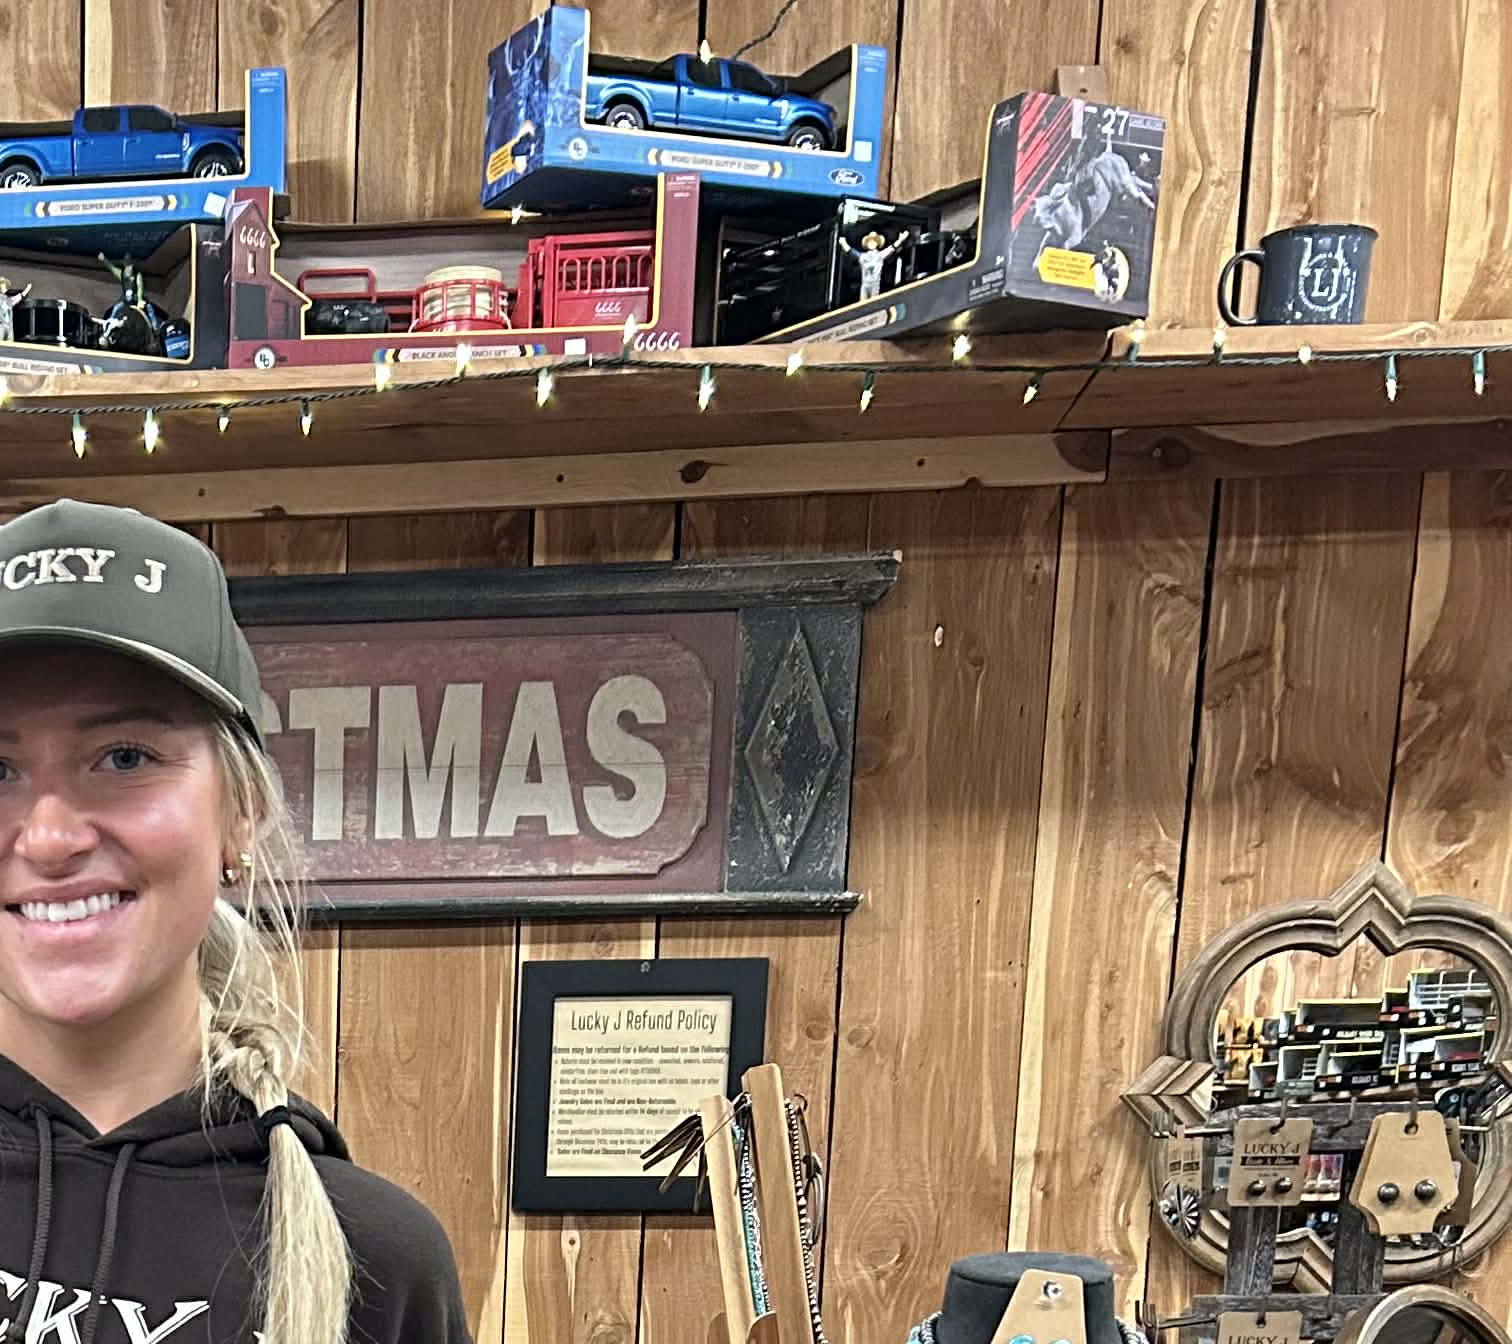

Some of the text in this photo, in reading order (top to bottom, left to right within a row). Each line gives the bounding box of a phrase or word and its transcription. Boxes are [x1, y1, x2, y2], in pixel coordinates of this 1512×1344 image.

[134, 558, 167, 593] J
[571, 1008, 718, 1035] Lucky J Refund Policy
[1244, 1143, 1289, 1155] LUCKY
